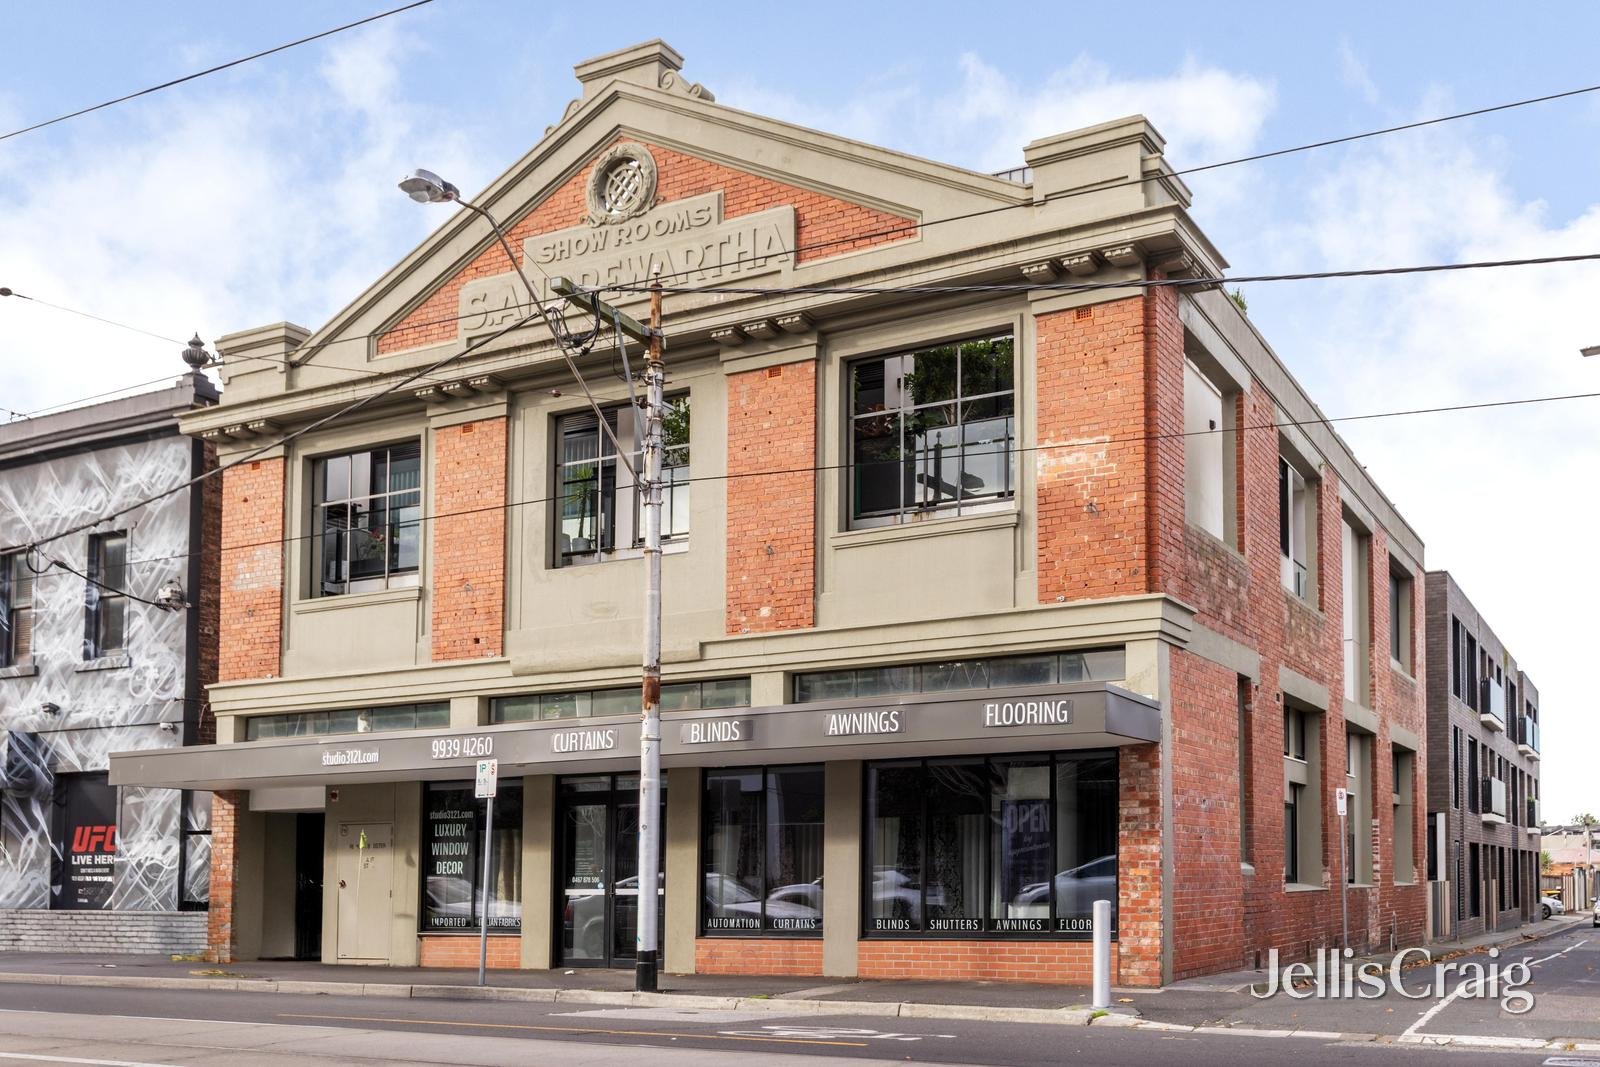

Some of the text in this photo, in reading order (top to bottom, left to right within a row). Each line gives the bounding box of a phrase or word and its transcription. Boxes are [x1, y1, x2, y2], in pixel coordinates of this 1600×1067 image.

[984, 700, 1068, 726] FLOORING
[828, 711, 900, 735] AWNINGS
[690, 721, 740, 743] BLINDS
[432, 736, 493, 759] 9939 4260
[553, 730, 614, 753] CURTAINS
[322, 750, 379, 766] studio3121.com
[430, 810, 473, 820] studio3121.com
[1008, 804, 1050, 833] OPEN
[434, 823, 467, 837] LUXURY
[431, 842, 469, 856] WINDOW
[71, 855, 115, 865] LIVE HER
[436, 861, 463, 875] DECOR
[707, 918, 761, 929] AUTOMATION
[773, 918, 816, 929] CURTAINS
[876, 919, 910, 930] BLINDS
[929, 919, 979, 930] SHUTTERS
[996, 919, 1042, 930] AWNINGS
